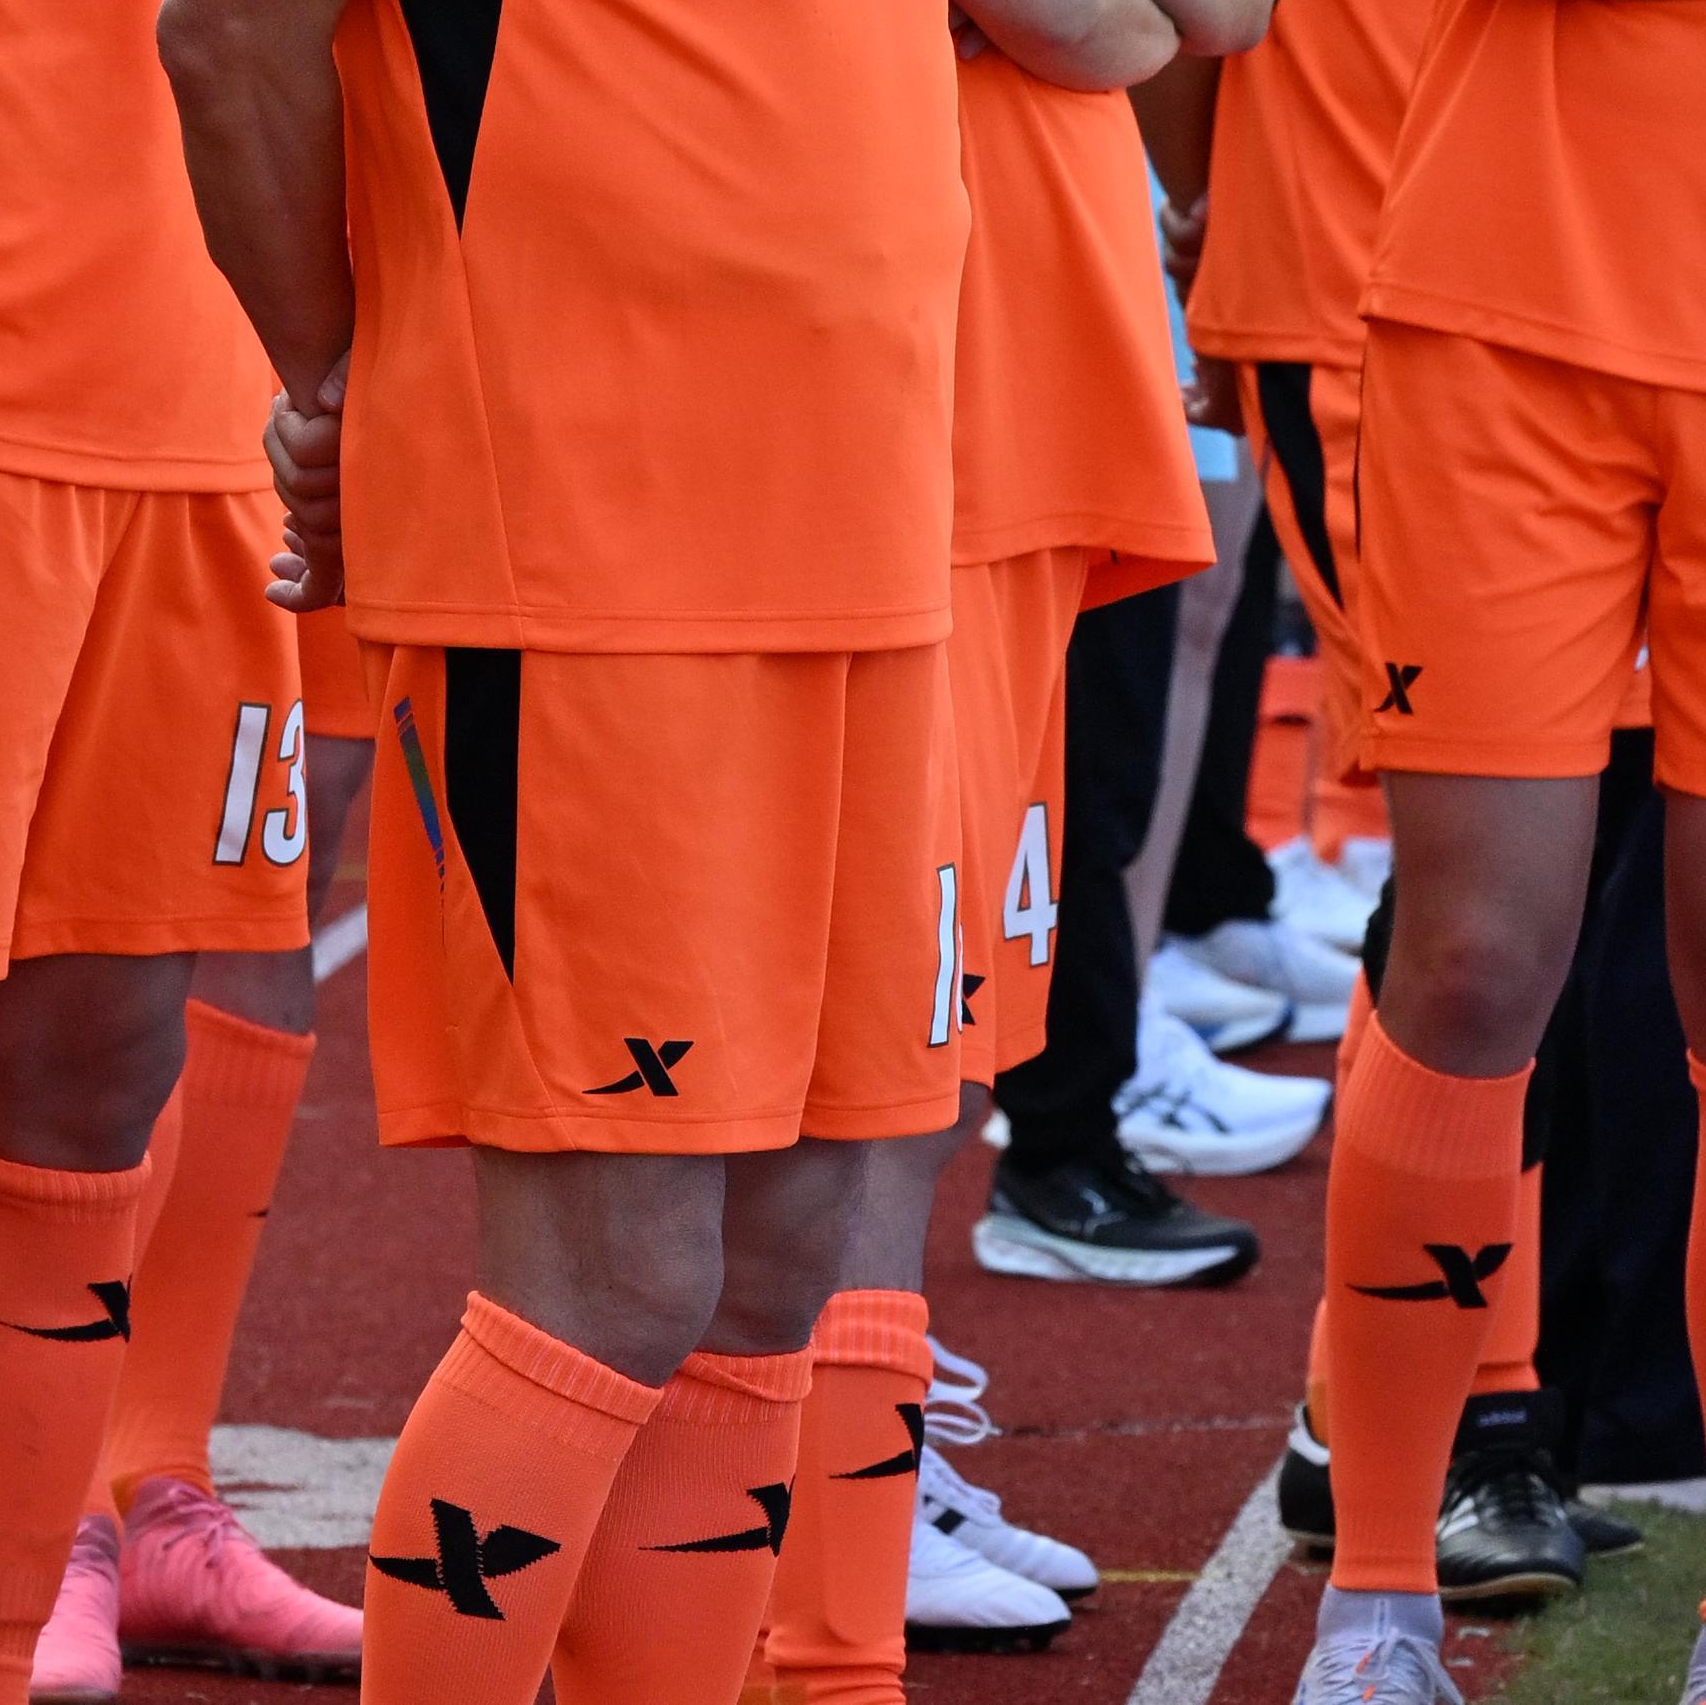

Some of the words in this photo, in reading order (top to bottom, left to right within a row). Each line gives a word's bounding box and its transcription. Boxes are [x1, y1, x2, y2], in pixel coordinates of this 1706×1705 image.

[212, 698, 307, 866] 13
[927, 861, 963, 1048] 1
[1002, 800, 1059, 967] 4
